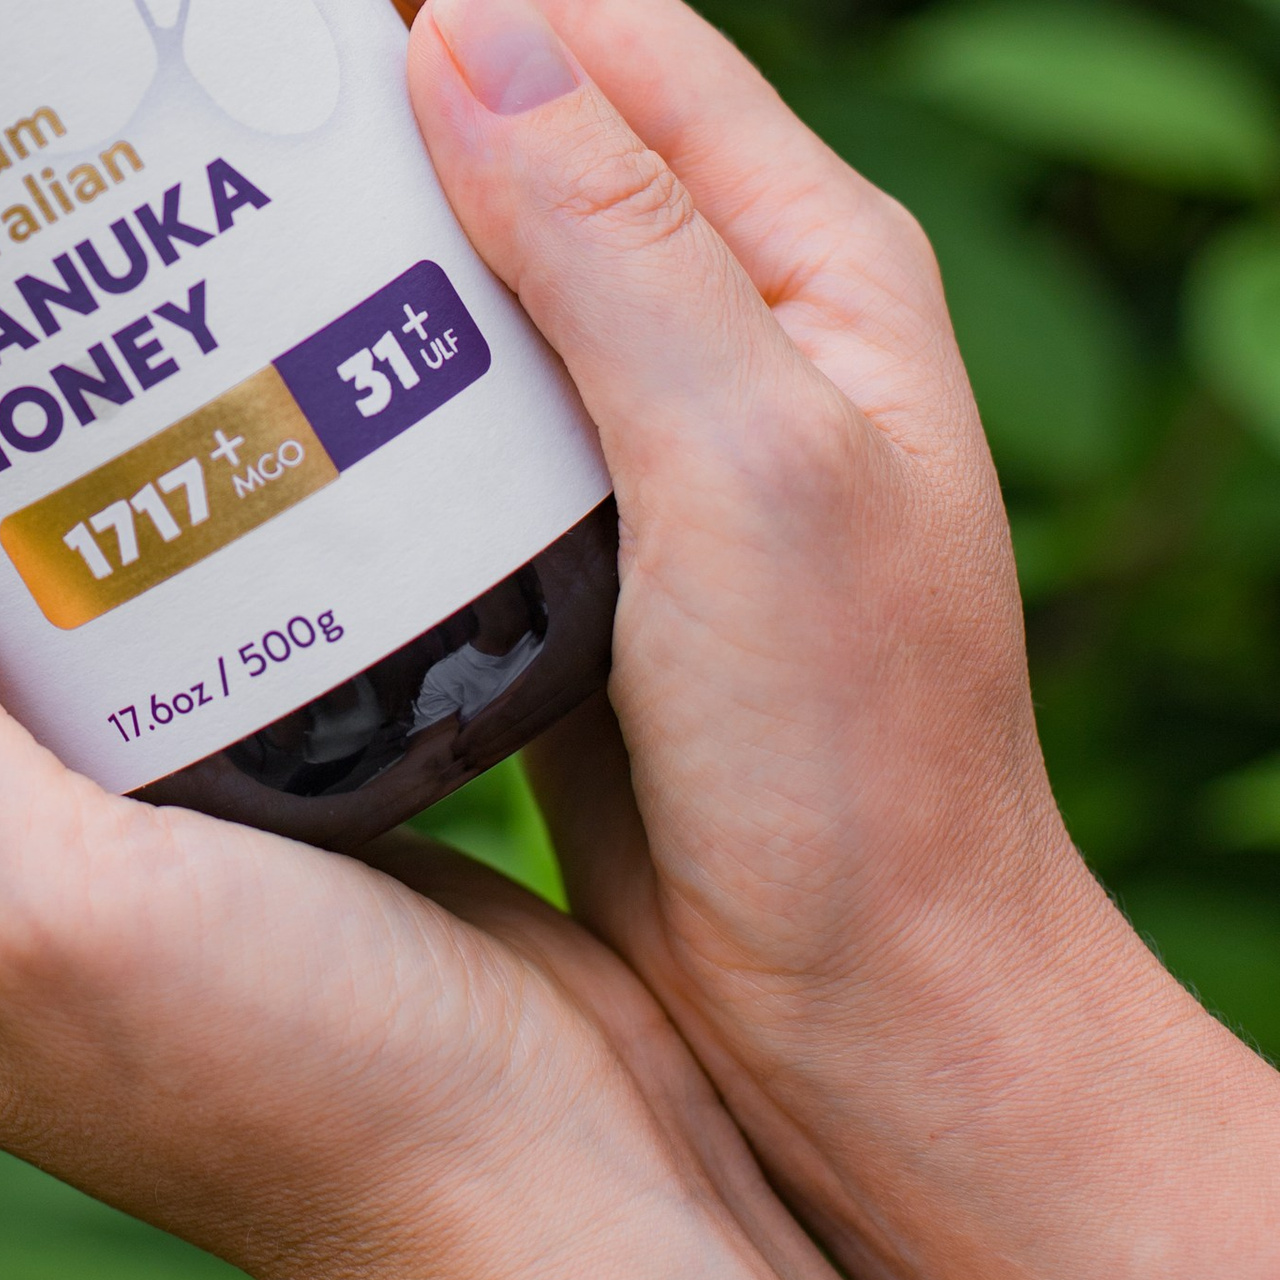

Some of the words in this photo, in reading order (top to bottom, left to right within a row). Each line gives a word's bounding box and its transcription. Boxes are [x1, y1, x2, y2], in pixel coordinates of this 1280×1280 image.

[420, 328, 459, 370] ULF
[107, 681, 213, 742] 17.6oz
[238, 609, 344, 677] 500g
